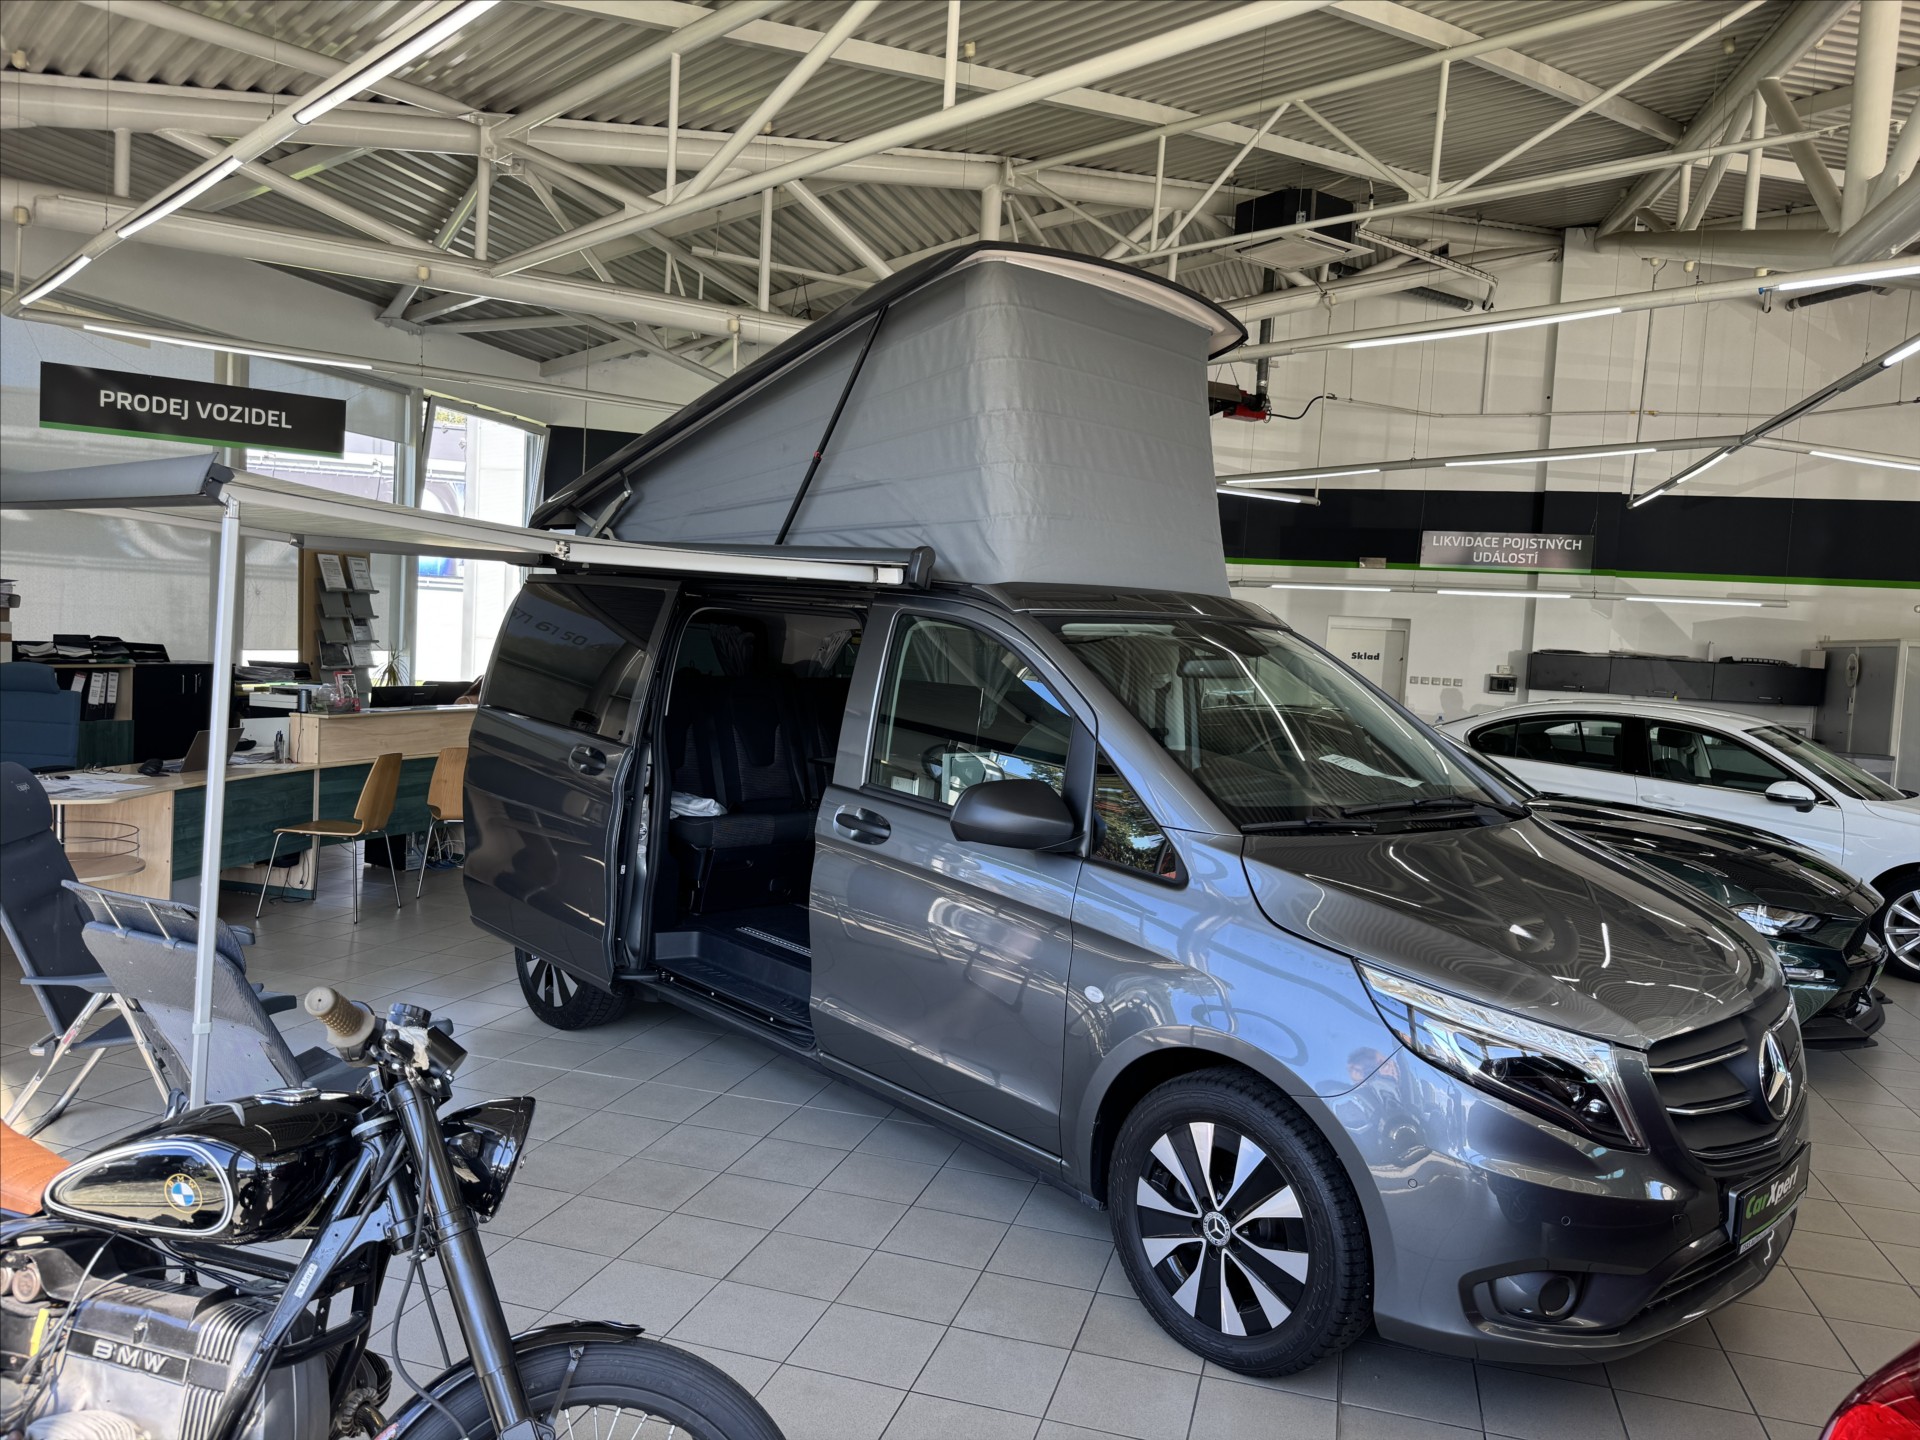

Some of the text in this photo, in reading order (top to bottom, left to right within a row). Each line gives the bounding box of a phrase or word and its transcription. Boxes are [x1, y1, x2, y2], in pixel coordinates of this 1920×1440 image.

[100, 389, 292, 429] PRODEJ VOZIDEL
[1432, 535, 1582, 550] LIKVIDACE POJISTNÝCH
[1473, 551, 1539, 564] UDÁLOSTÍ
[560, 631, 588, 646] 50
[1351, 652, 1380, 661] Sklad
[1745, 1165, 1799, 1219] CarXpert
[92, 1339, 169, 1373] BMW
